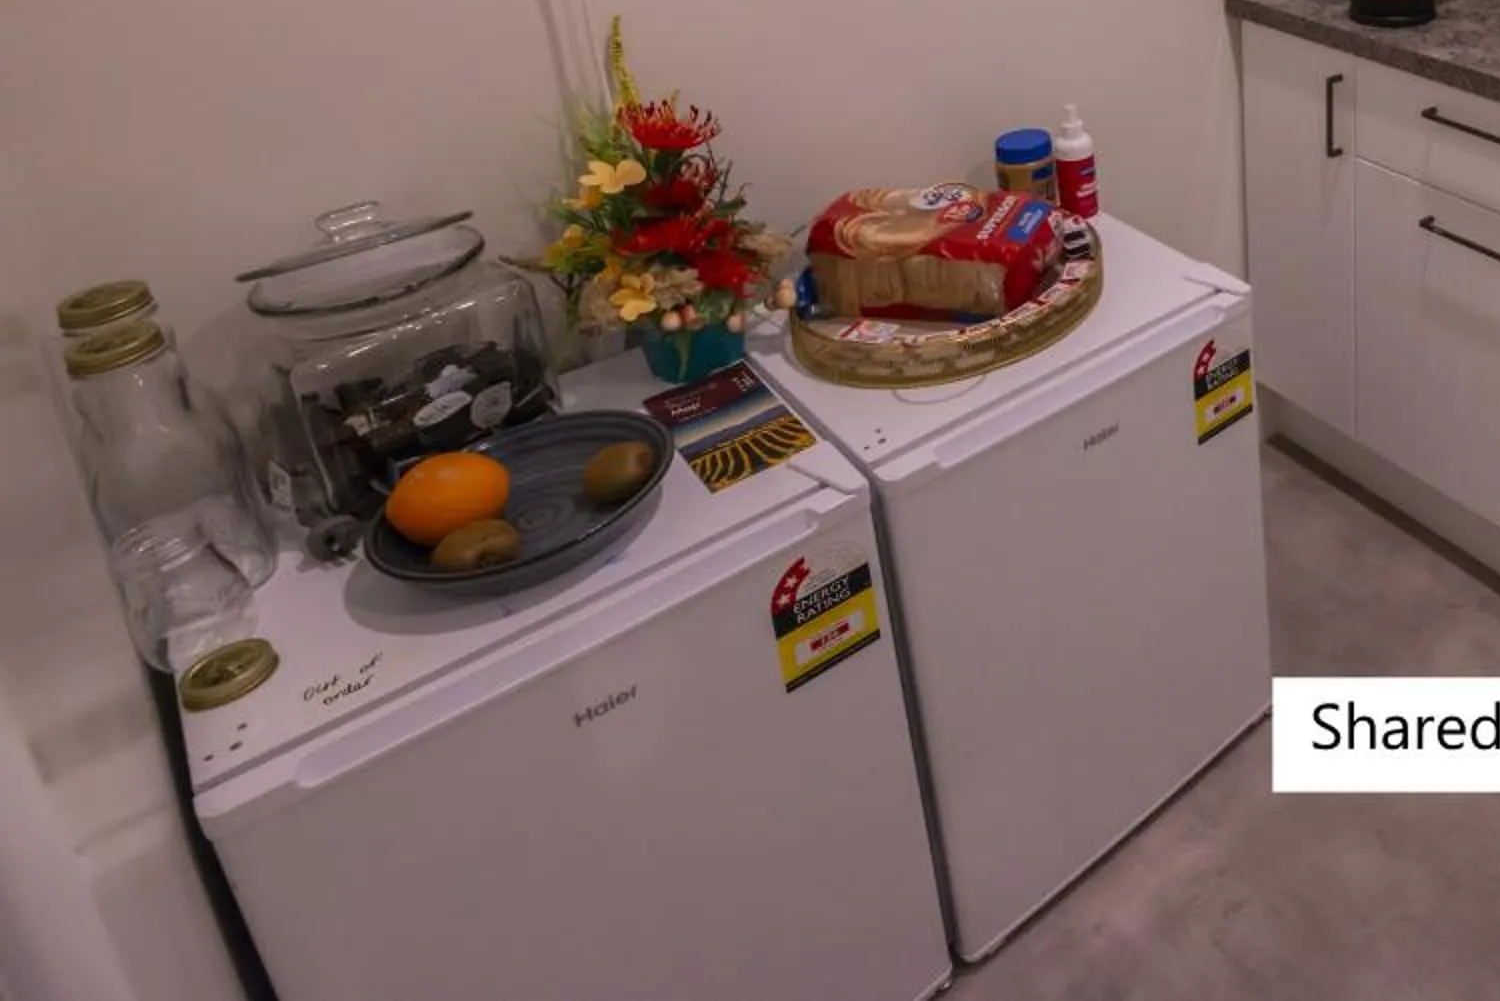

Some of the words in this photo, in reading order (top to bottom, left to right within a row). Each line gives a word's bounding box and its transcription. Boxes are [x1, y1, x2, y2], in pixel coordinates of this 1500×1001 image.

[792, 575, 849, 615] ENERGY
[797, 589, 851, 625] RATING
[573, 683, 638, 728] Haier
